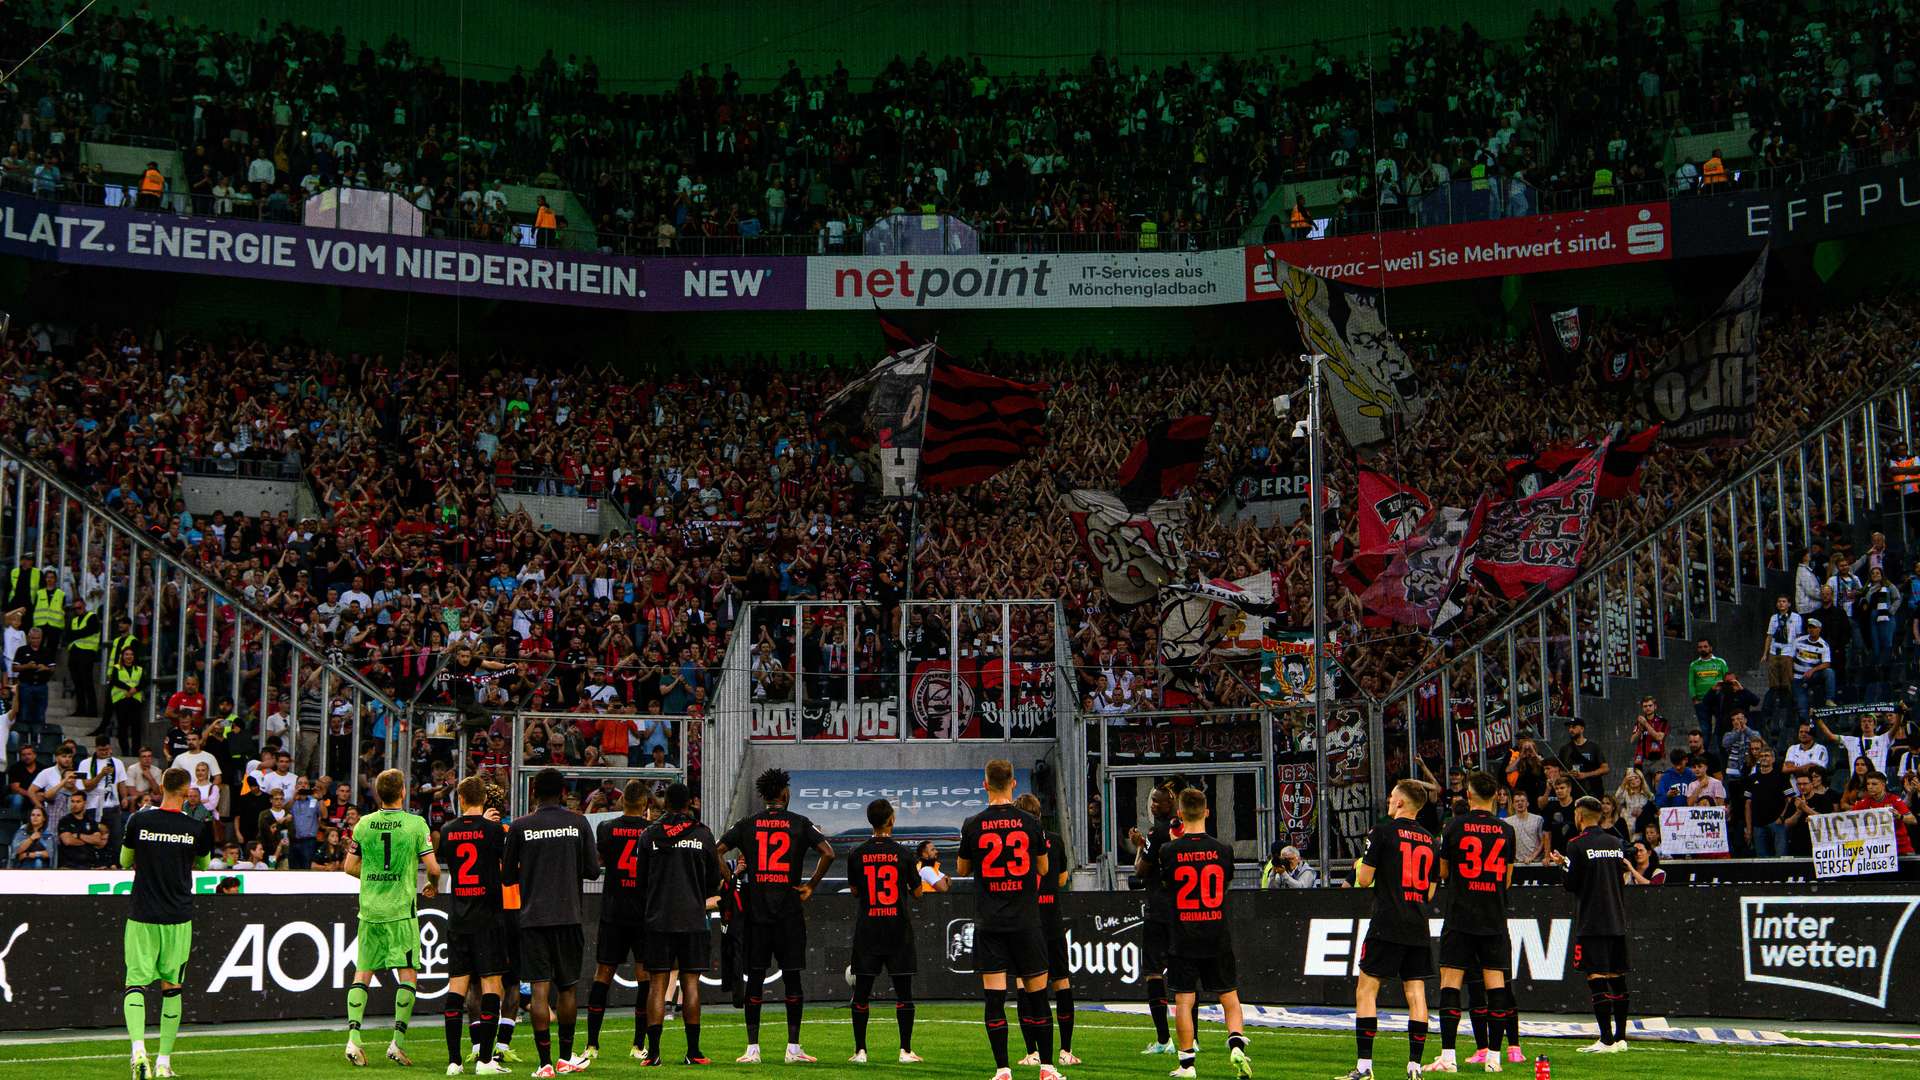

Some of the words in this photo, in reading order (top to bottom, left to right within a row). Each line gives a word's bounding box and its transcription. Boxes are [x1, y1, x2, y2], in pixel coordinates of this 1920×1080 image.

[0, 206, 115, 252] LATZ.
[128, 222, 296, 267] ENERGIE
[307, 238, 386, 276] VOM
[395, 246, 647, 298] NIEDERRHEIN.
[1384, 256, 1424, 273] weil
[1428, 249, 1459, 268] Sie
[1464, 237, 1562, 264] Mehrwert
[1567, 231, 1617, 253] sind.
[1082, 265, 1170, 279] IT-Services
[1176, 265, 1203, 278] aus
[684, 269, 765, 297] NEW
[835, 258, 1052, 306] netpoint
[1068, 280, 1217, 298] Mönchengladbach
[799, 786, 987, 798] Elektrisier
[1283, 794, 1312, 805] BAYER
[807, 799, 863, 811] die
[370, 821, 393, 830] BAYER
[755, 819, 780, 829] BAYER
[780, 820, 791, 829] 04
[981, 819, 1010, 830] BAYER
[1010, 818, 1024, 829] 04
[1288, 818, 1305, 830] 04
[1664, 809, 1684, 831] 4
[1697, 822, 1720, 834] TAH
[1810, 812, 1892, 843] VICTOR
[139, 829, 194, 845] Barmenia
[448, 831, 473, 841] BAYER
[473, 830, 484, 840] 04
[524, 825, 579, 841] Barmenia
[1397, 828, 1423, 842] BAYER
[1464, 823, 1491, 834] BAYER
[1491, 824, 1503, 835] 04
[381, 832, 392, 871] 1
[617, 839, 638, 879] 4
[755, 831, 791, 872] 12
[862, 853, 887, 863] BAYER
[887, 853, 898, 863] 04
[978, 830, 1031, 878] 23
[1177, 851, 1206, 863] BAYER
[1206, 850, 1218, 861] 04
[1458, 835, 1506, 882] 34
[1815, 848, 1834, 860] can
[1842, 844, 1864, 857] have
[1866, 844, 1891, 859] your
[456, 842, 480, 885] 2
[1399, 841, 1434, 891] 10
[1815, 859, 1854, 875] JERSEY
[1857, 858, 1887, 875] please
[366, 872, 402, 882] HRADECKY
[620, 879, 636, 888] TAH
[755, 873, 789, 883] TAPSOBA
[864, 865, 899, 906] 13
[990, 879, 1023, 892] HLOŽEK
[1174, 863, 1225, 910] 20
[1468, 881, 1496, 893] XHAKA
[1180, 910, 1222, 922] GRIMALDO
[1753, 903, 1836, 940] inter
[206, 920, 384, 993] AOK
[1065, 928, 1140, 984] burg
[1760, 940, 1877, 968] wetten
